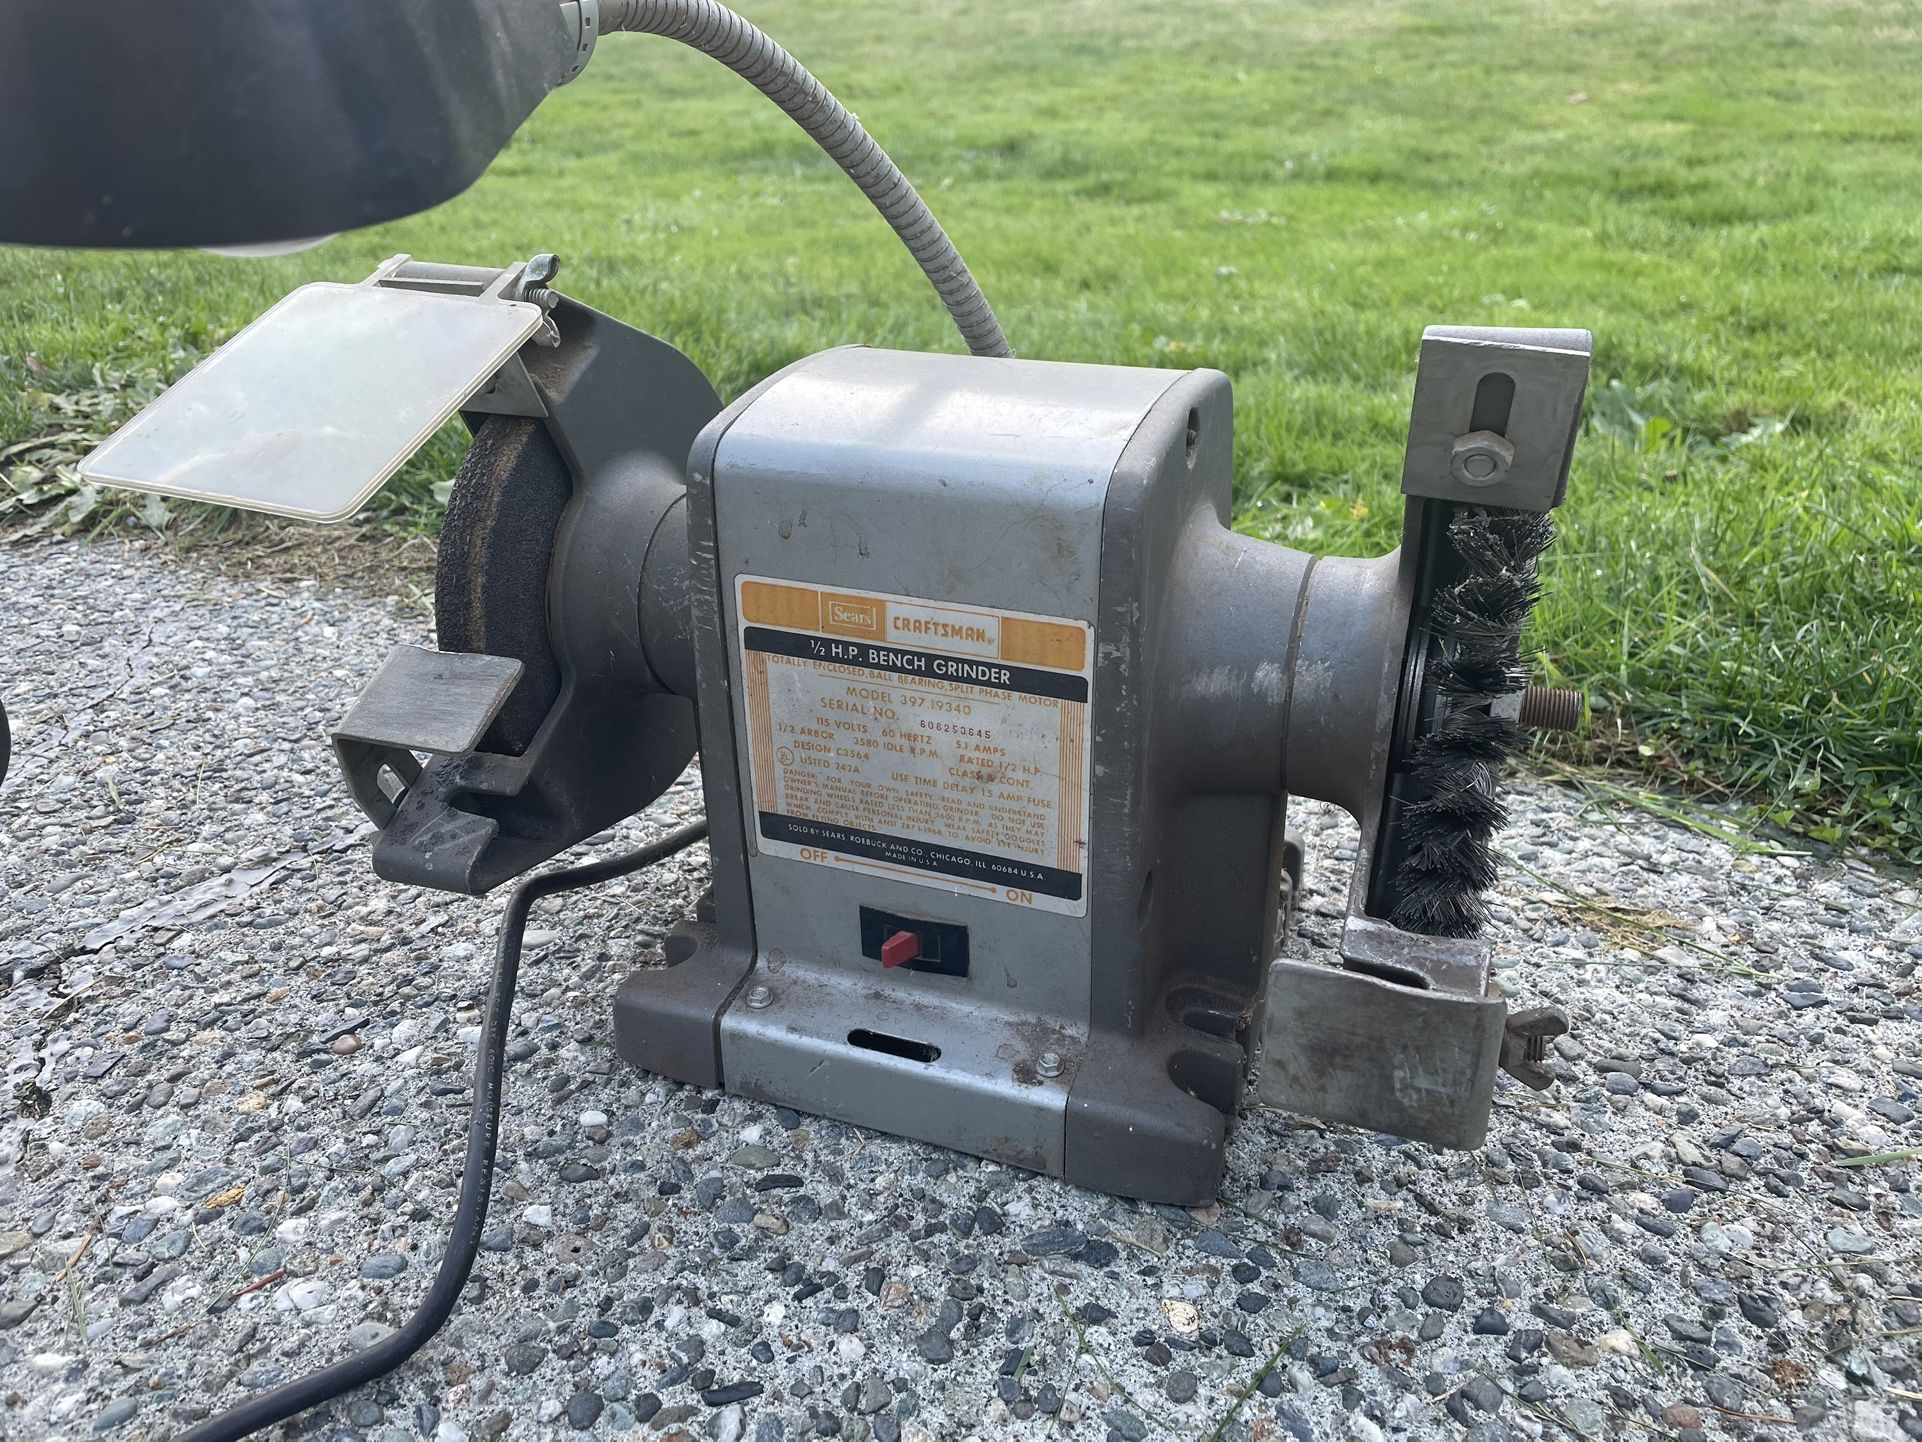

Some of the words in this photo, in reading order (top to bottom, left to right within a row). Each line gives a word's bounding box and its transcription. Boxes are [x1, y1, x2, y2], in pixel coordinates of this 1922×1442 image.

[833, 606, 873, 625] Sears
[767, 655, 808, 670] TOTALLY
[949, 683, 974, 695] SPLIT
[979, 687, 1013, 700] PHASE
[1018, 693, 1060, 709] MOTOR
[831, 643, 863, 661] H.P.
[868, 650, 926, 671] BENCH
[933, 659, 1011, 685] GRINDER
[820, 697, 867, 715] SERIAL
[873, 706, 899, 720] NO.
[846, 686, 893, 704] MODEL
[900, 694, 972, 716] 397.19340
[778, 723, 795, 734] 1/2
[800, 727, 835, 740] ARBOR
[853, 737, 879, 748] 3580
[883, 742, 905, 753] IDLE
[959, 754, 994, 768] RATED
[999, 760, 1017, 772] 1/2
[816, 717, 830, 727] 115
[835, 720, 868, 733] VOLTS
[882, 728, 896, 738] 60
[900, 732, 932, 744] HERTZ
[955, 740, 968, 750] 5.1
[974, 744, 1006, 757] AMPS
[793, 740, 831, 754] DESIGN
[836, 747, 870, 761] C3564
[948, 767, 981, 782] CLASS
[800, 755, 830, 768] LISTED
[834, 762, 860, 774] 242A
[891, 772, 910, 782] USE
[914, 776, 938, 787] TIME
[943, 782, 976, 794] DELAY
[982, 788, 993, 798] 15
[998, 792, 1022, 802] AMP
[1027, 797, 1053, 809] FUSE
[784, 784, 823, 797] GRINDING
[826, 792, 856, 803] WHEELS
[860, 799, 884, 808] RATED
[888, 804, 905, 812] LESS
[908, 807, 931, 816] THAN
[987, 821, 998, 829] AS
[1025, 829, 1045, 838] MAY
[785, 793, 809, 802] BREAK
[814, 798, 831, 807] AND
[834, 802, 860, 812] CAUSE
[863, 807, 903, 820] PERSONAL
[786, 809, 808, 818] FROM
[822, 784, 857, 795] MANUAL
[860, 790, 889, 801] BEFORE
[1008, 817, 1026, 826] NOT
[1031, 821, 1045, 830] USE
[826, 775, 842, 783] FOR
[850, 780, 872, 789] YOUR
[877, 785, 899, 794] OWN
[941, 796, 963, 806] READ
[967, 800, 985, 809] AND
[989, 805, 1046, 821] UNDERSTAND
[786, 801, 811, 811] WHICH
[817, 807, 849, 819] COMPLY
[853, 813, 874, 823] WITH
[964, 834, 992, 845] AVOID
[788, 823, 808, 833] SOLD
[850, 835, 887, 849] ROEBUCK
[889, 843, 909, 853] AND
[991, 864, 1018, 875] 60684
[800, 847, 828, 862] OFF
[885, 851, 906, 861] MADE
[1006, 888, 1032, 904] ON
